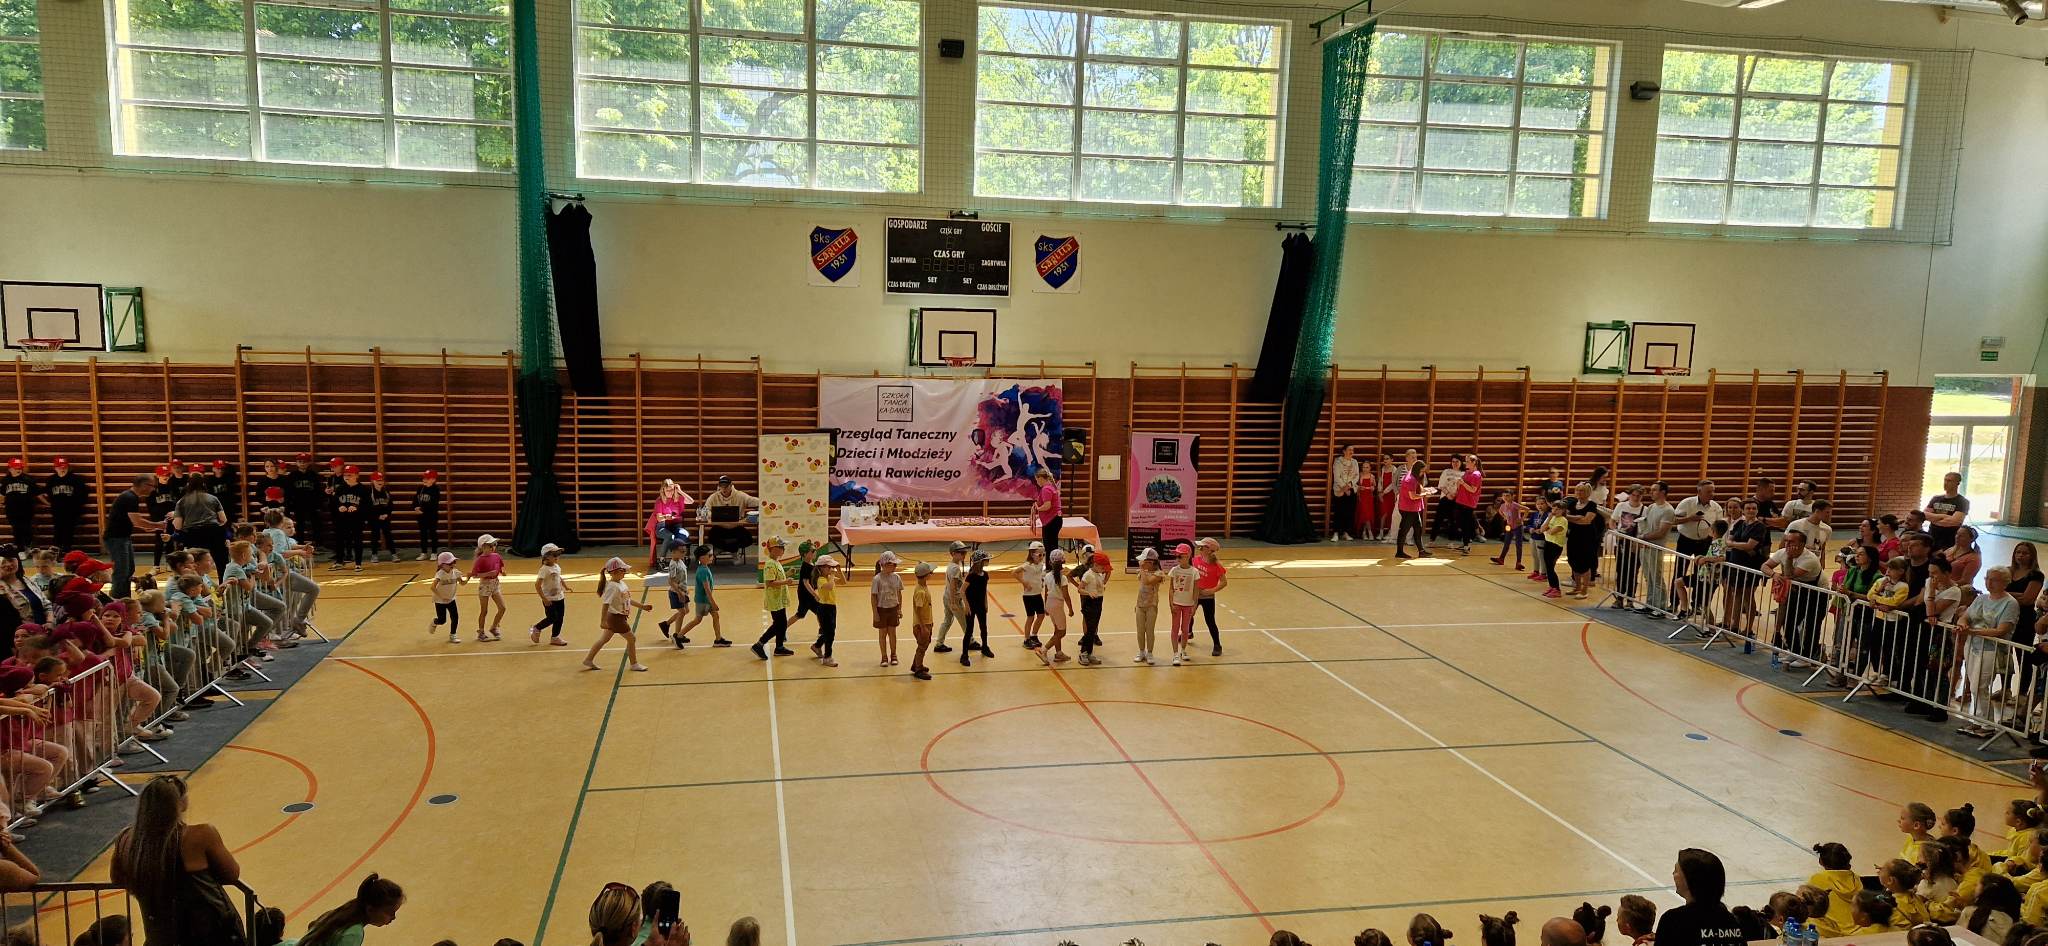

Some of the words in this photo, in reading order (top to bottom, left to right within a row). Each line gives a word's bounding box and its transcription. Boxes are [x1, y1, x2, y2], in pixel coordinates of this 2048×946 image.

[888, 219, 928, 230] GOSPODARZE
[981, 222, 1002, 233] GOŚCIE
[890, 256, 917, 264] ZAGRYWKA
[933, 250, 950, 258] CZAS
[951, 250, 965, 259] GRY
[830, 254, 848, 269] 1931
[981, 259, 1007, 267] ZAGRYWKA
[1053, 261, 1070, 276] 1931
[962, 277, 973, 285] SET
[835, 428, 893, 442] Przegląd
[896, 428, 957, 442] Taneczny
[837, 447, 877, 459] Dzieci
[880, 448, 885, 459] i
[887, 448, 952, 461] Młodzieży
[829, 467, 882, 478] Powiatu
[885, 467, 961, 481] Rawickiego
